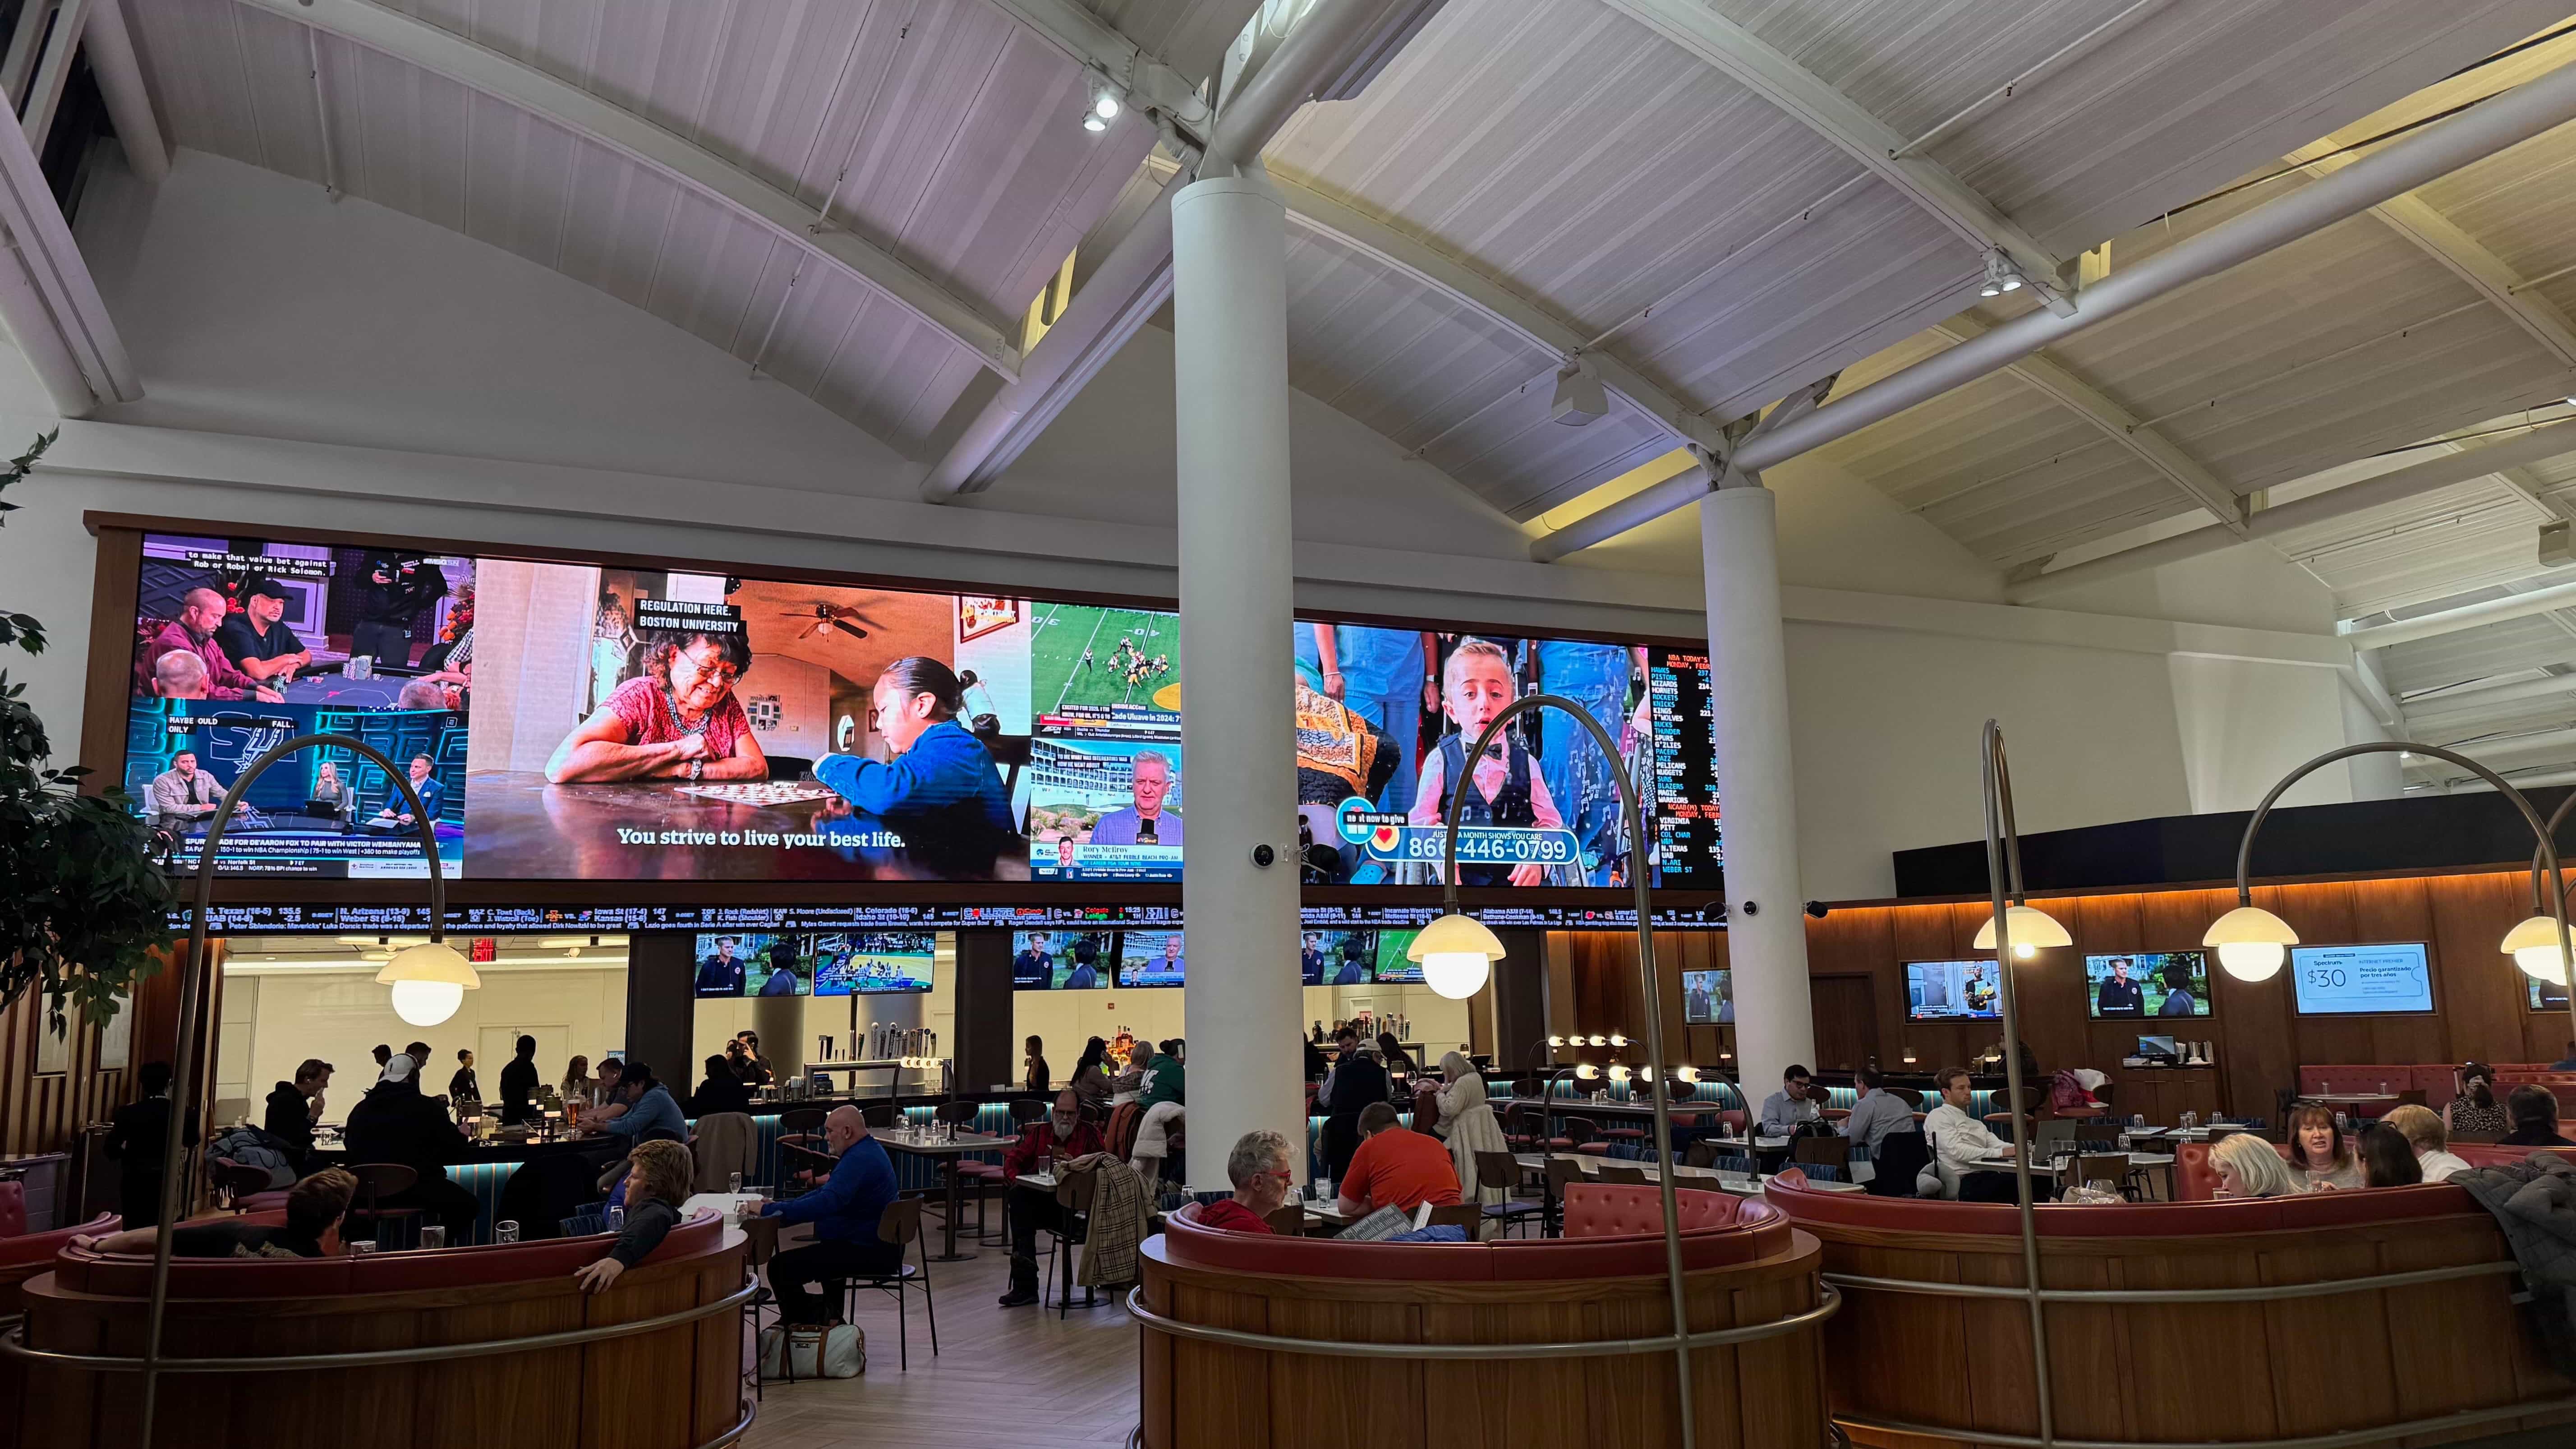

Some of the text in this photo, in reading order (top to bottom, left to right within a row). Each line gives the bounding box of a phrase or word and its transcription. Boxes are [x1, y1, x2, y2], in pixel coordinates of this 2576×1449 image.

[249, 555, 272, 563] value
[277, 557, 290, 565] bet
[295, 558, 327, 568] against
[290, 568, 326, 576] Solomon.
[640, 600, 731, 616] REGULATION HERE.
[639, 616, 739, 632] BOSTON UNIVERSITY
[1156, 714, 1174, 722] 2024:
[1366, 815, 1380, 823] now
[1381, 814, 1389, 823] to
[1390, 815, 1405, 825] give
[617, 828, 905, 849] You strive to live your best life.
[2308, 969, 2346, 987] $30
